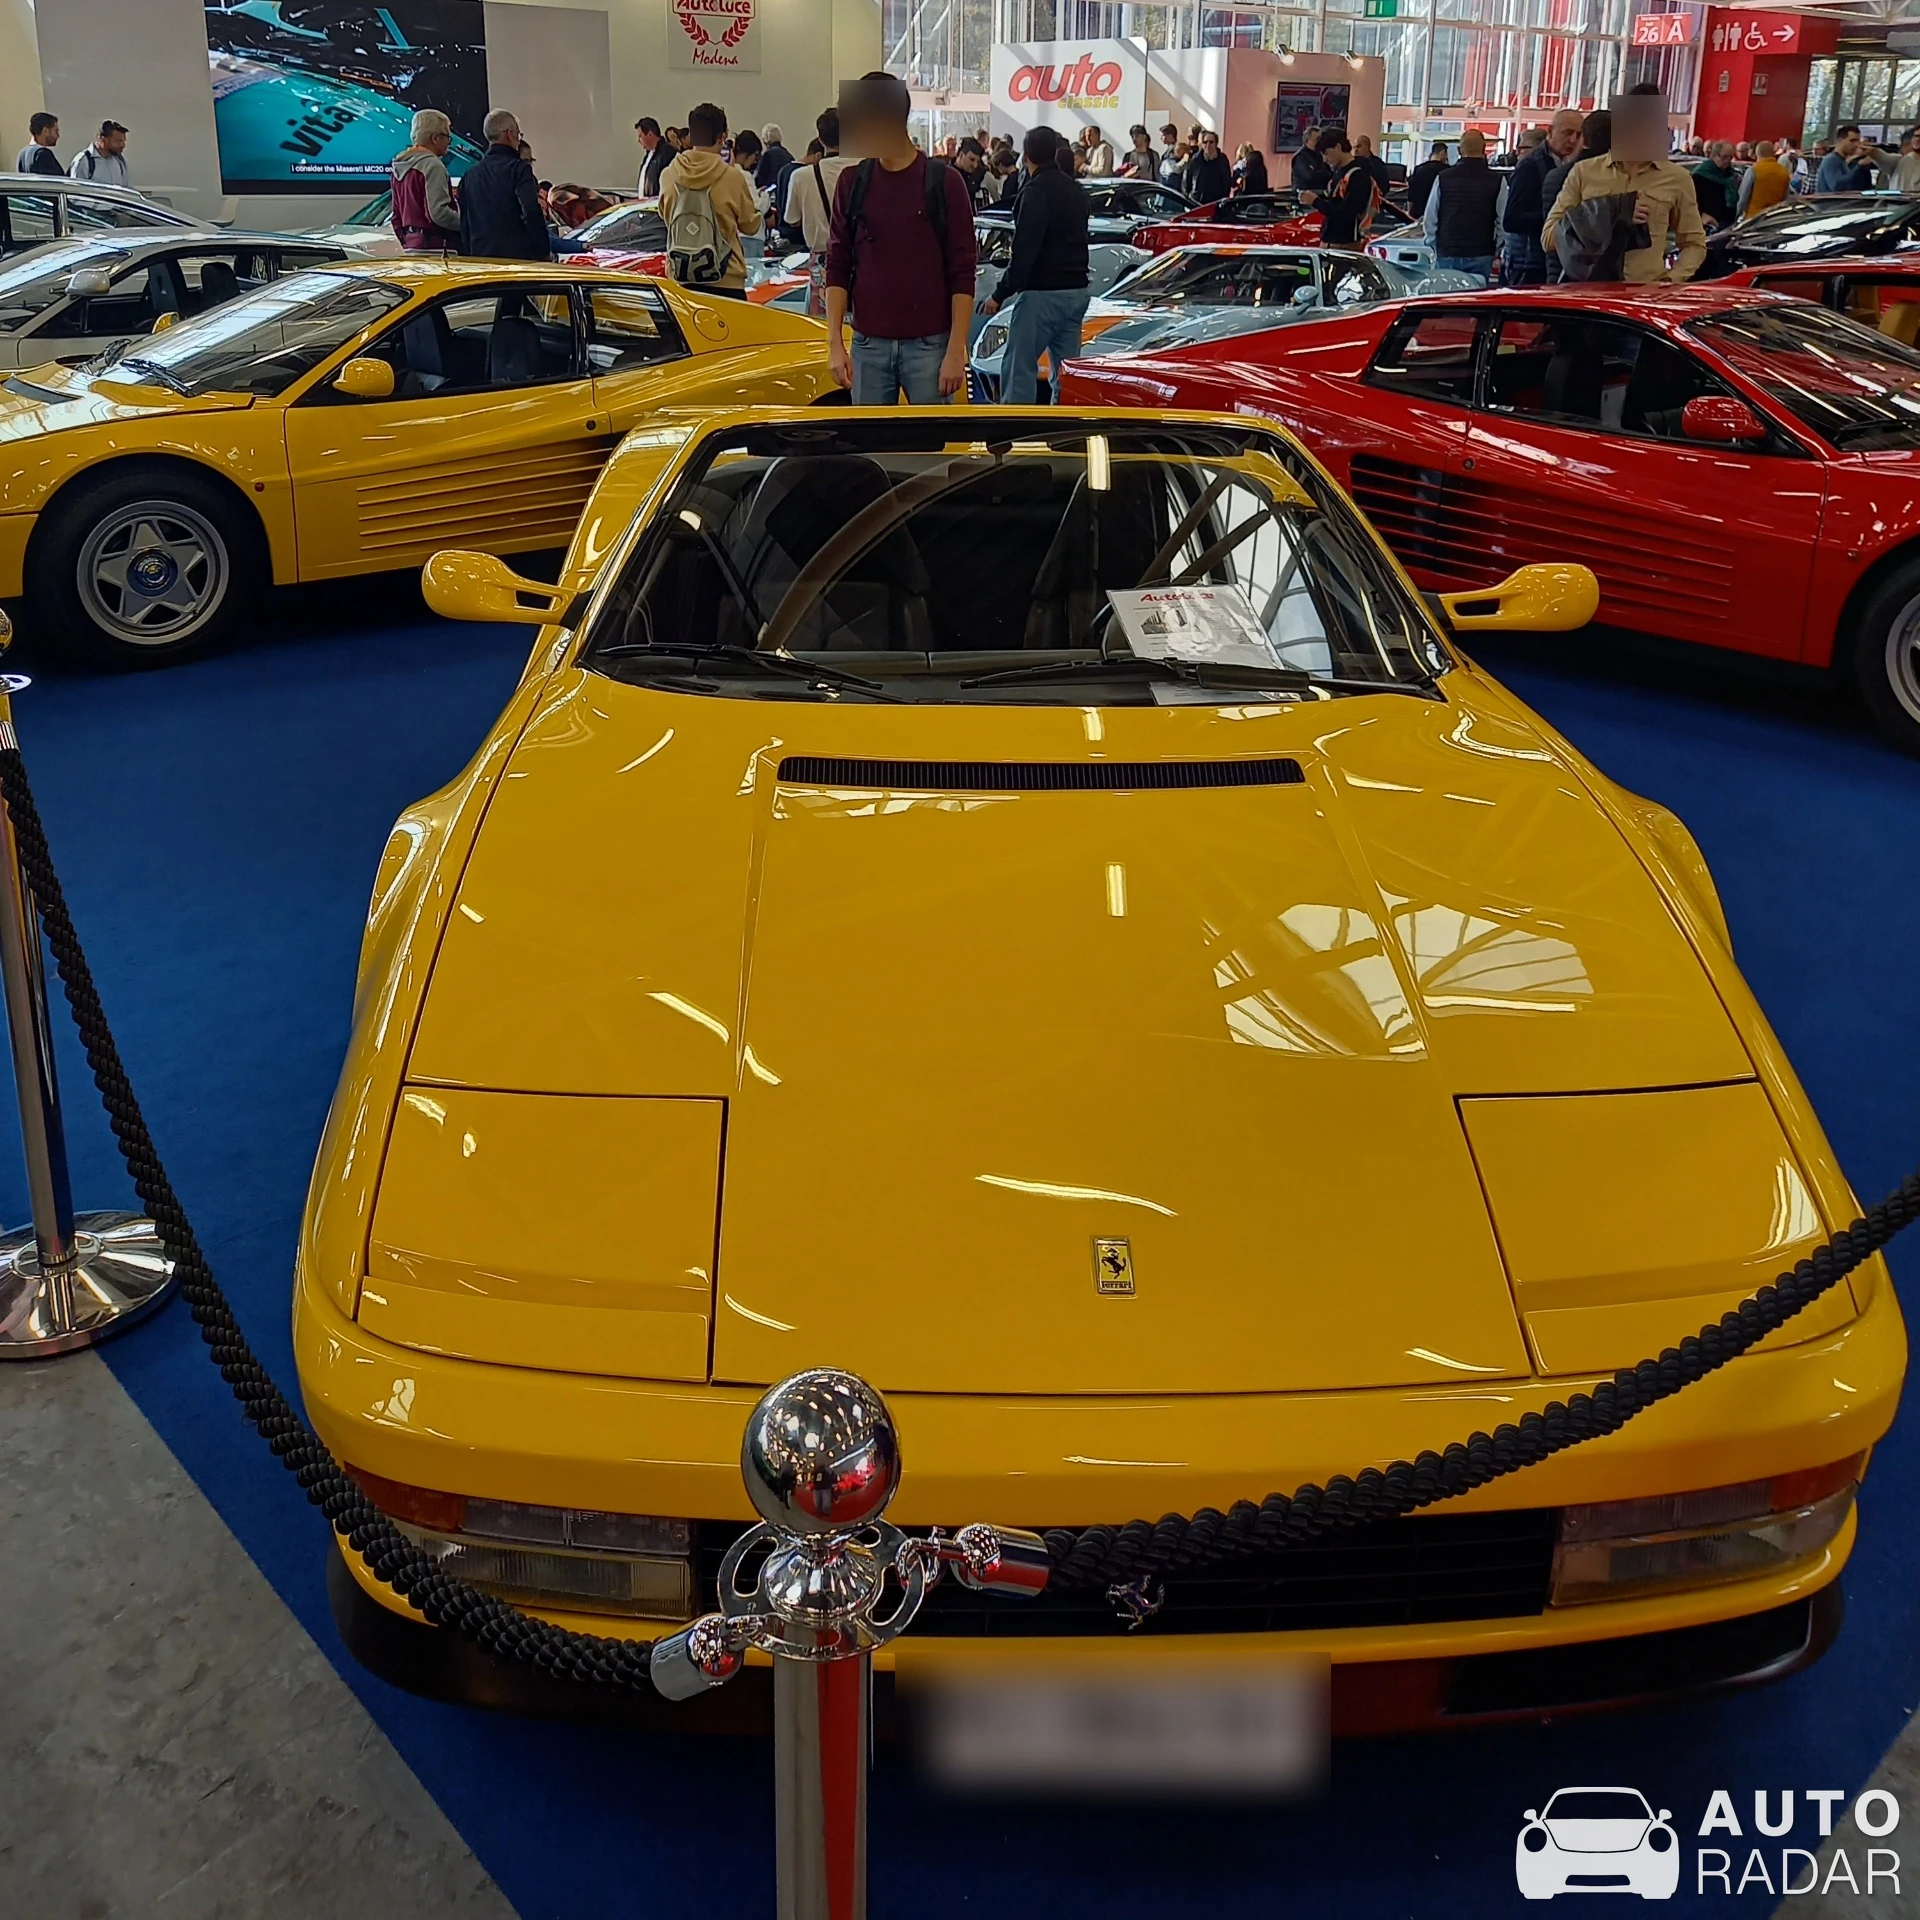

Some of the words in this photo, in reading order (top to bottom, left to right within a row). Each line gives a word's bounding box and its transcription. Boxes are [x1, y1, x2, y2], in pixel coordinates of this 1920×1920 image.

[677, 0, 751, 14] Autoluce
[1638, 26, 1659, 43] 26
[1666, 20, 1684, 42] A
[692, 47, 739, 66] Modena
[1009, 52, 1122, 102] auto
[1058, 95, 1119, 109] classic
[295, 164, 323, 173] consider
[324, 164, 335, 173] the
[336, 164, 363, 173] Maserati
[364, 165, 384, 173] MC20
